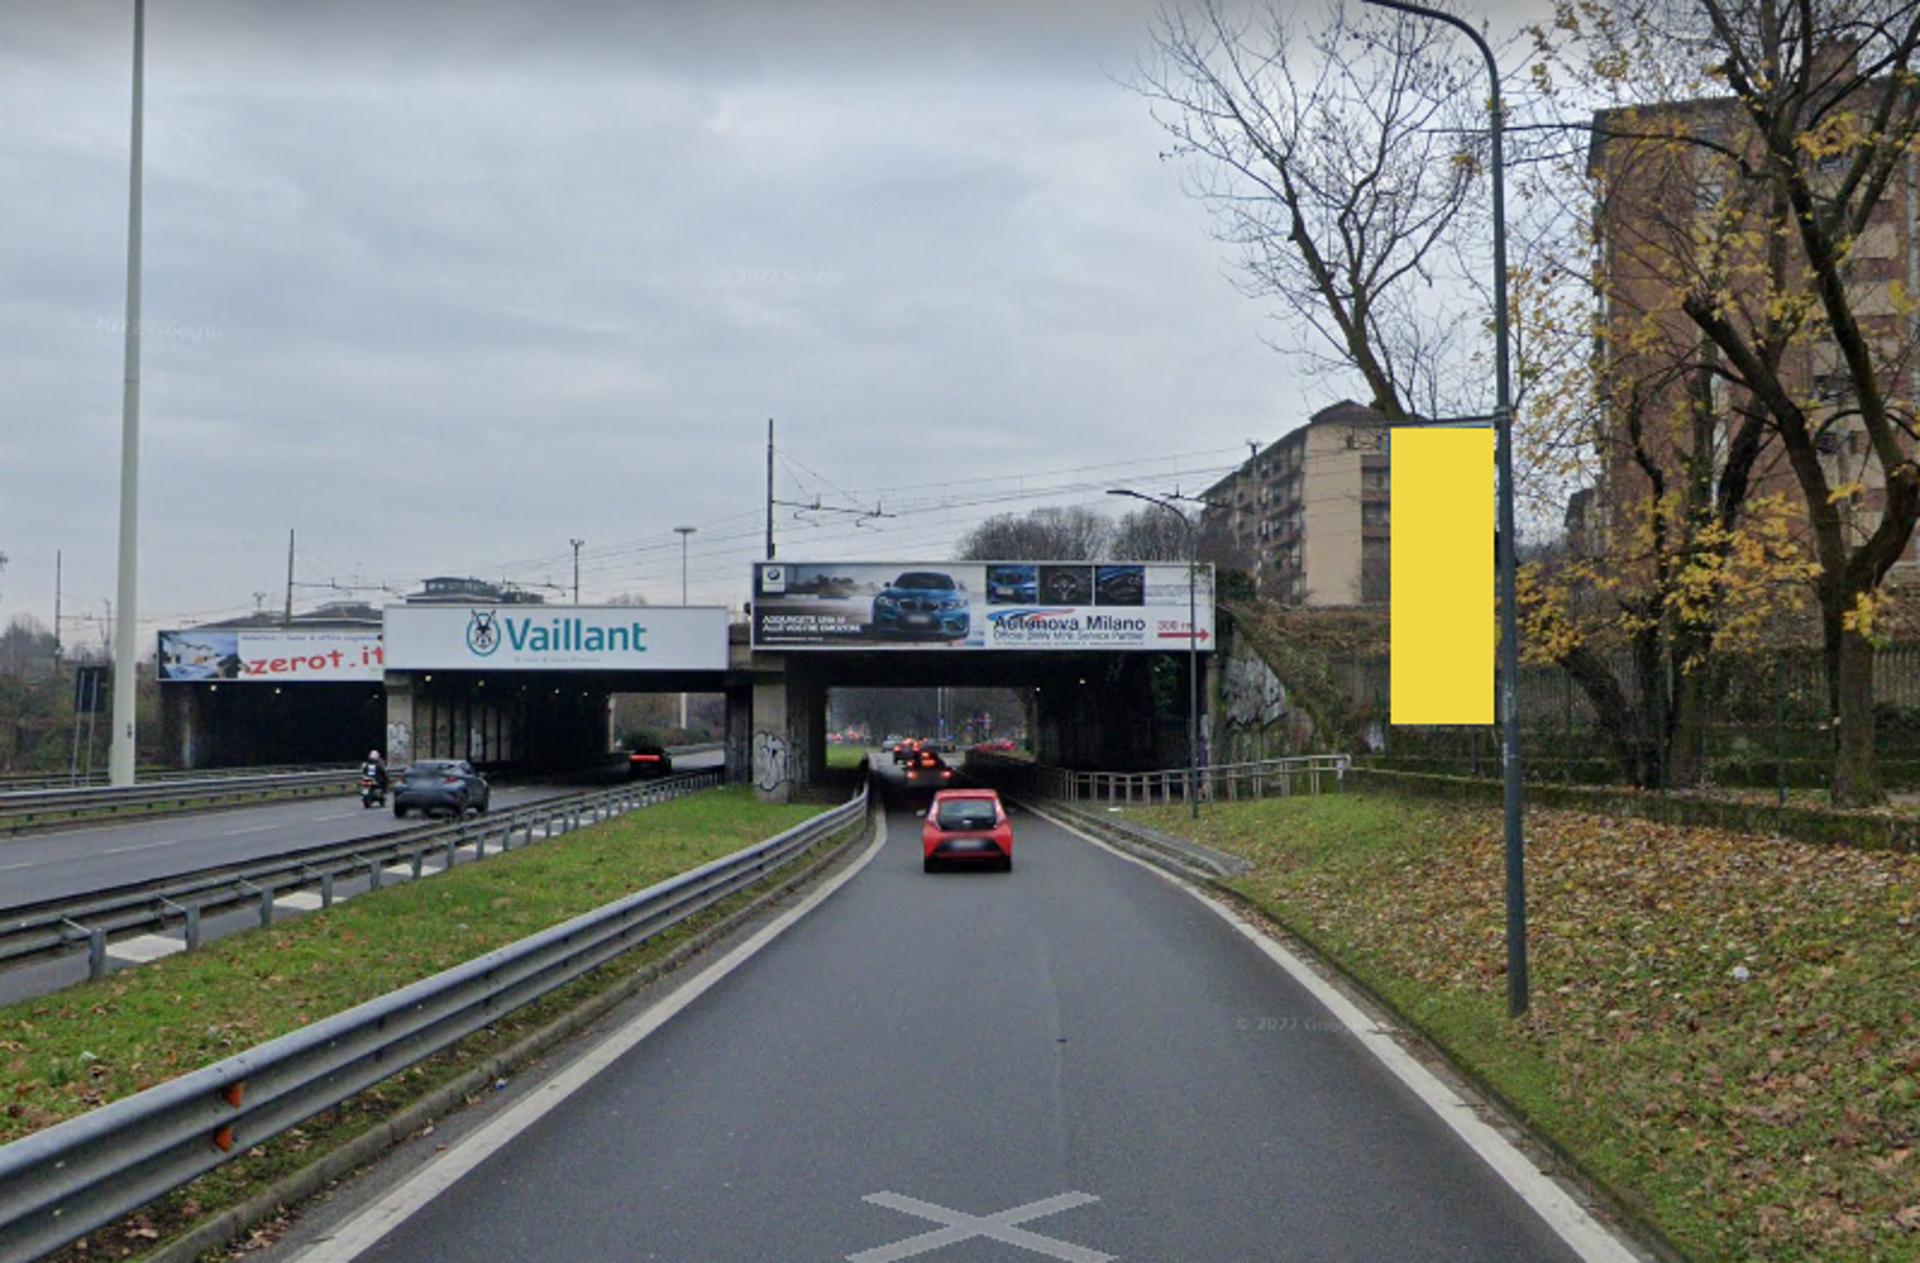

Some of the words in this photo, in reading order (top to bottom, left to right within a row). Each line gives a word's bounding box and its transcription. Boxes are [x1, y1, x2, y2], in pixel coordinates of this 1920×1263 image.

[505, 617, 648, 653] Vaillant
[993, 614, 1079, 631] Autonova
[1086, 614, 1147, 631] Milano
[249, 646, 384, 677] zerot.it
